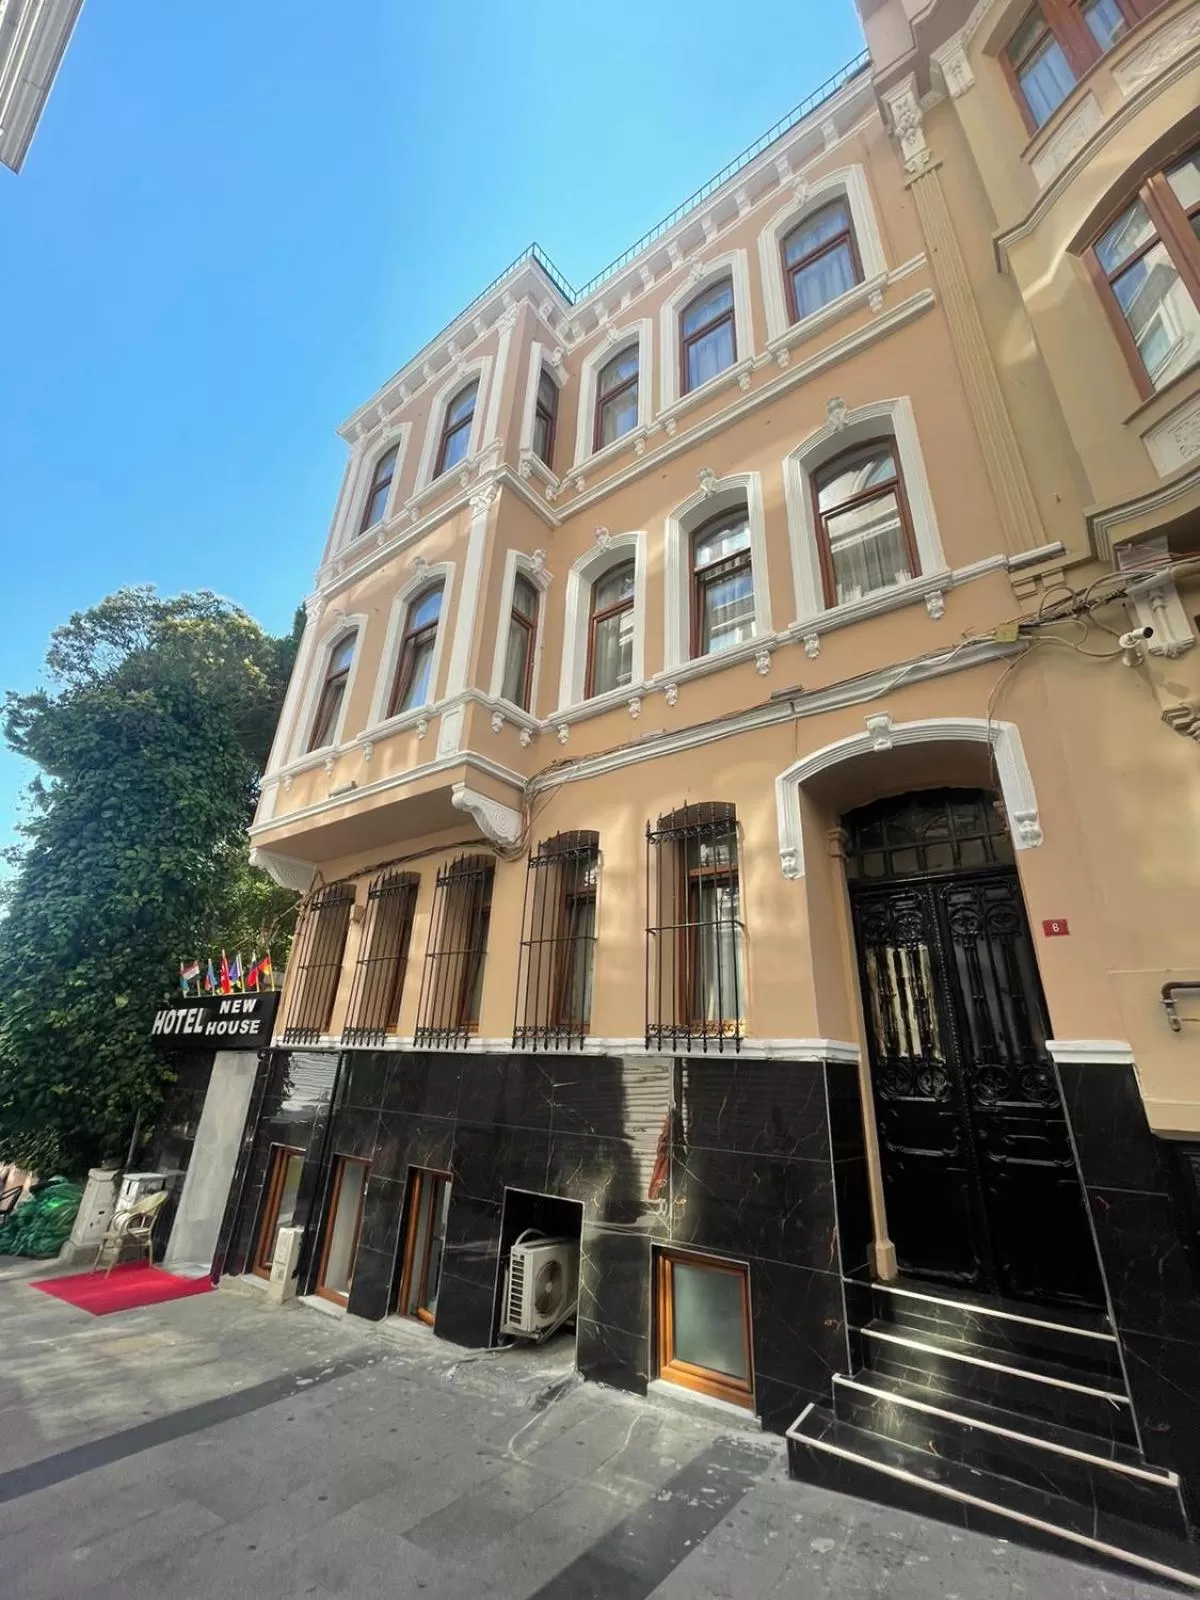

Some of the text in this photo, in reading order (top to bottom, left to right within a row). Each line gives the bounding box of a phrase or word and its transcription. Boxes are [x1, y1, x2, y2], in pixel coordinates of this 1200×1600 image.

[219, 998, 257, 1014] NEW
[151, 1007, 261, 1036] HOTEL HOUSE
